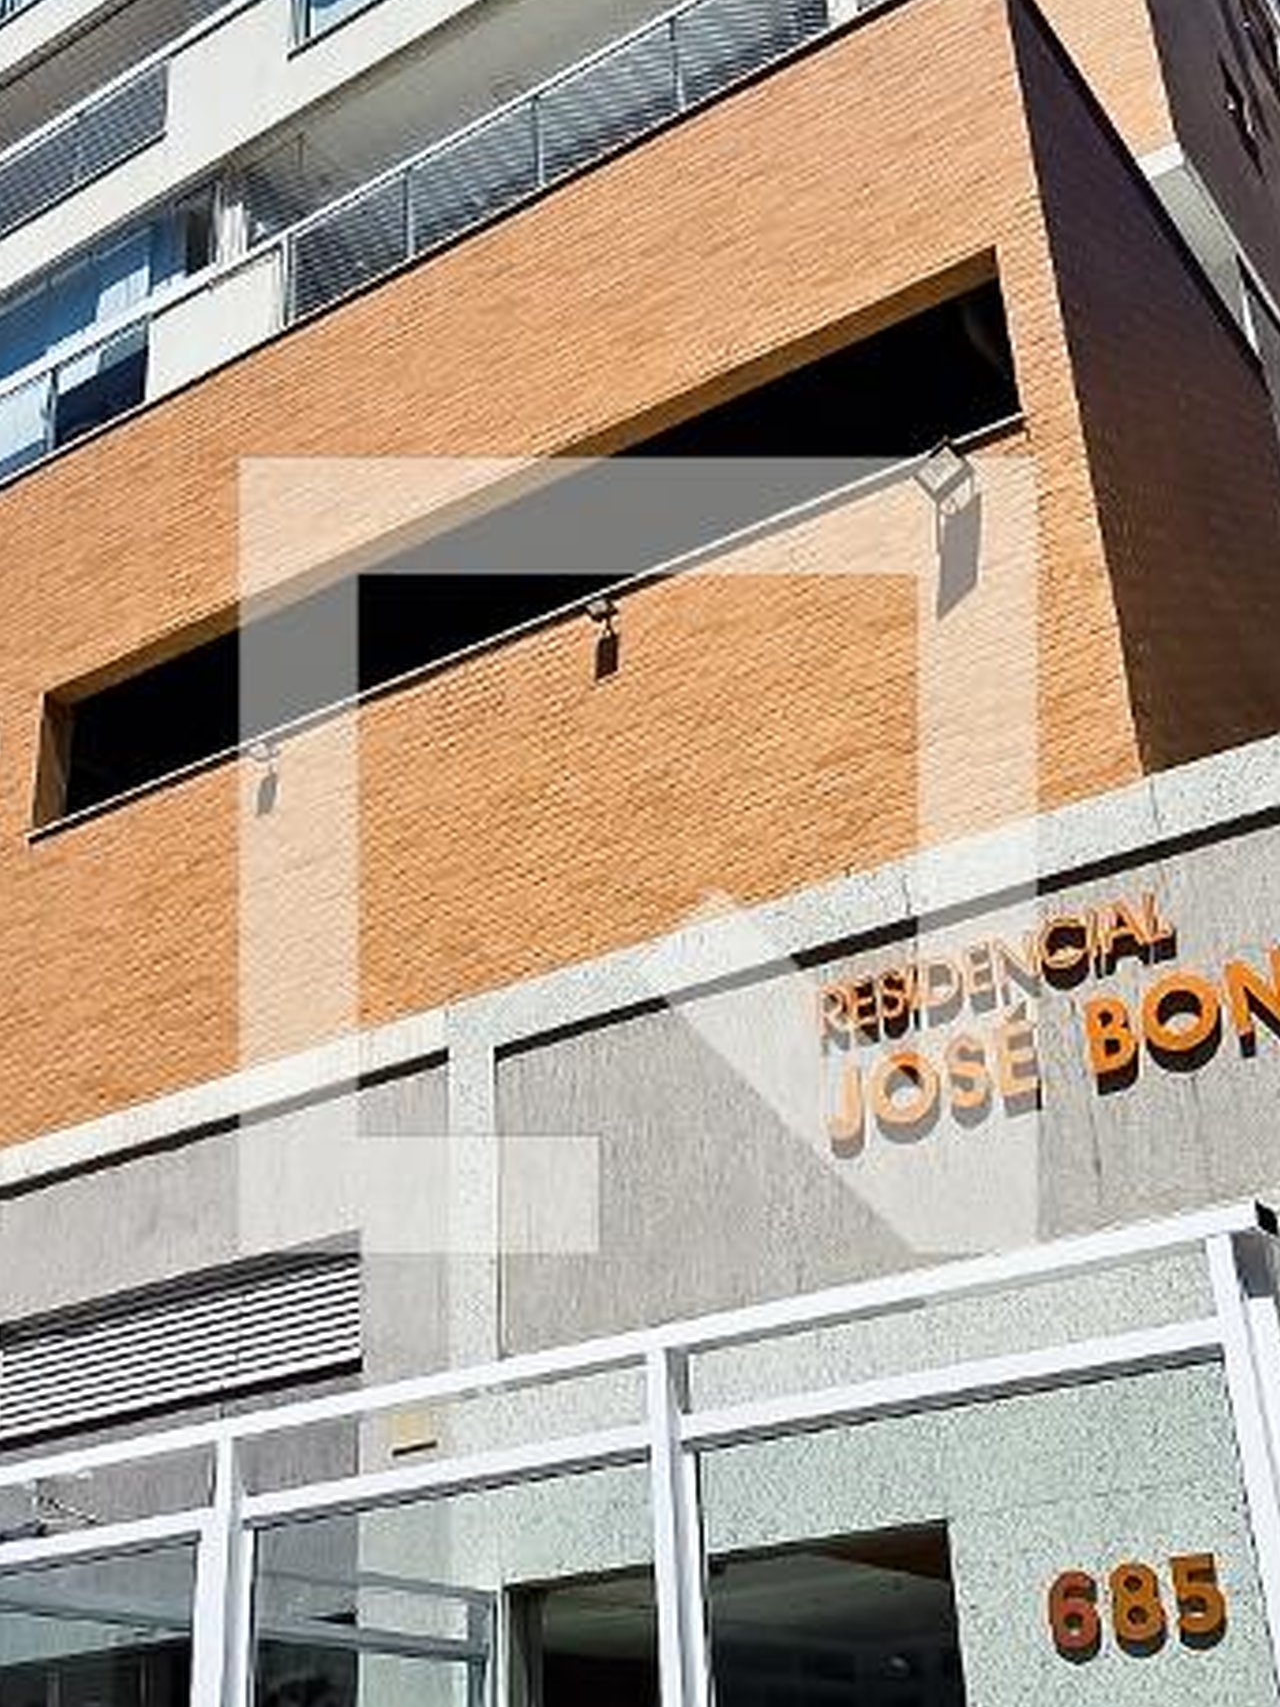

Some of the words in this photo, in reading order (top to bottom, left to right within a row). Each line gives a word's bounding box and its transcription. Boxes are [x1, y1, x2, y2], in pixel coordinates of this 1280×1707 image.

[821, 894, 1174, 1034] RESIDENCIAL
[826, 1000, 1040, 1142] JOSÉ
[1048, 1552, 1227, 1652] 685
